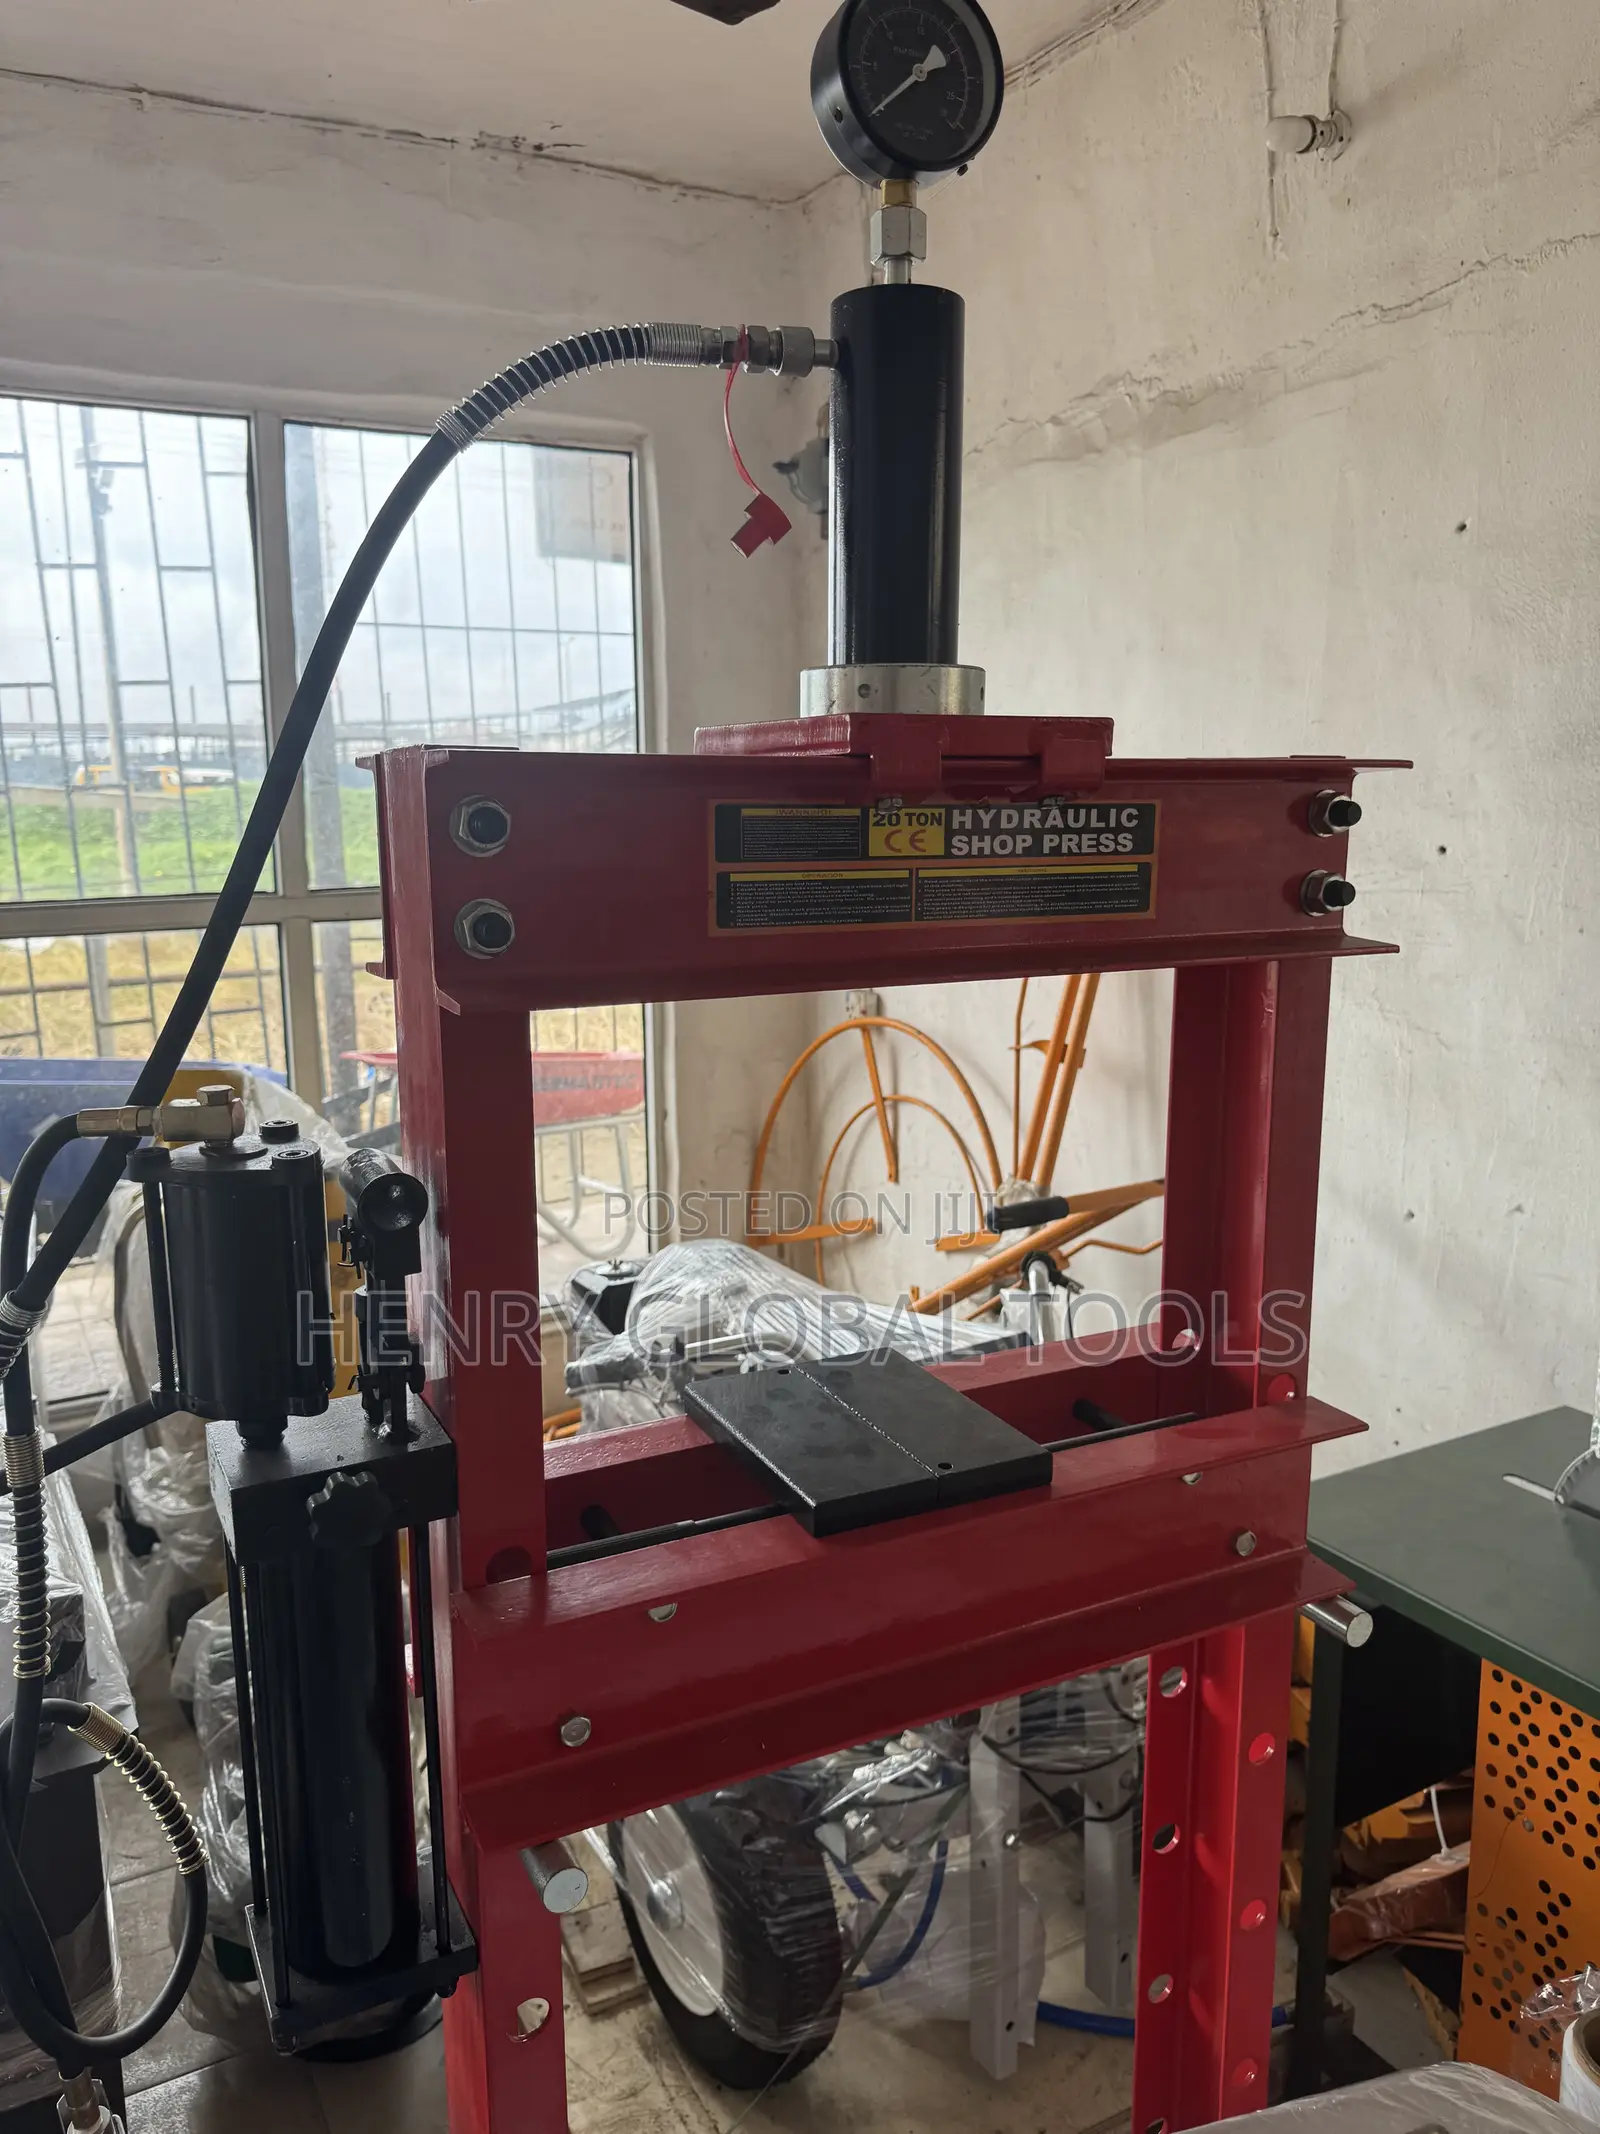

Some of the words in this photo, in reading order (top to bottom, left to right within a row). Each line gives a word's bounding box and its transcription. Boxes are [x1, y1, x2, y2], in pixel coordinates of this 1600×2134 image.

[872, 813, 900, 827] 20
[904, 812, 942, 827] TON
[953, 807, 1139, 830] HYDRAULIC
[950, 834, 1033, 856] SHOP
[1043, 832, 1134, 854] PRESS
